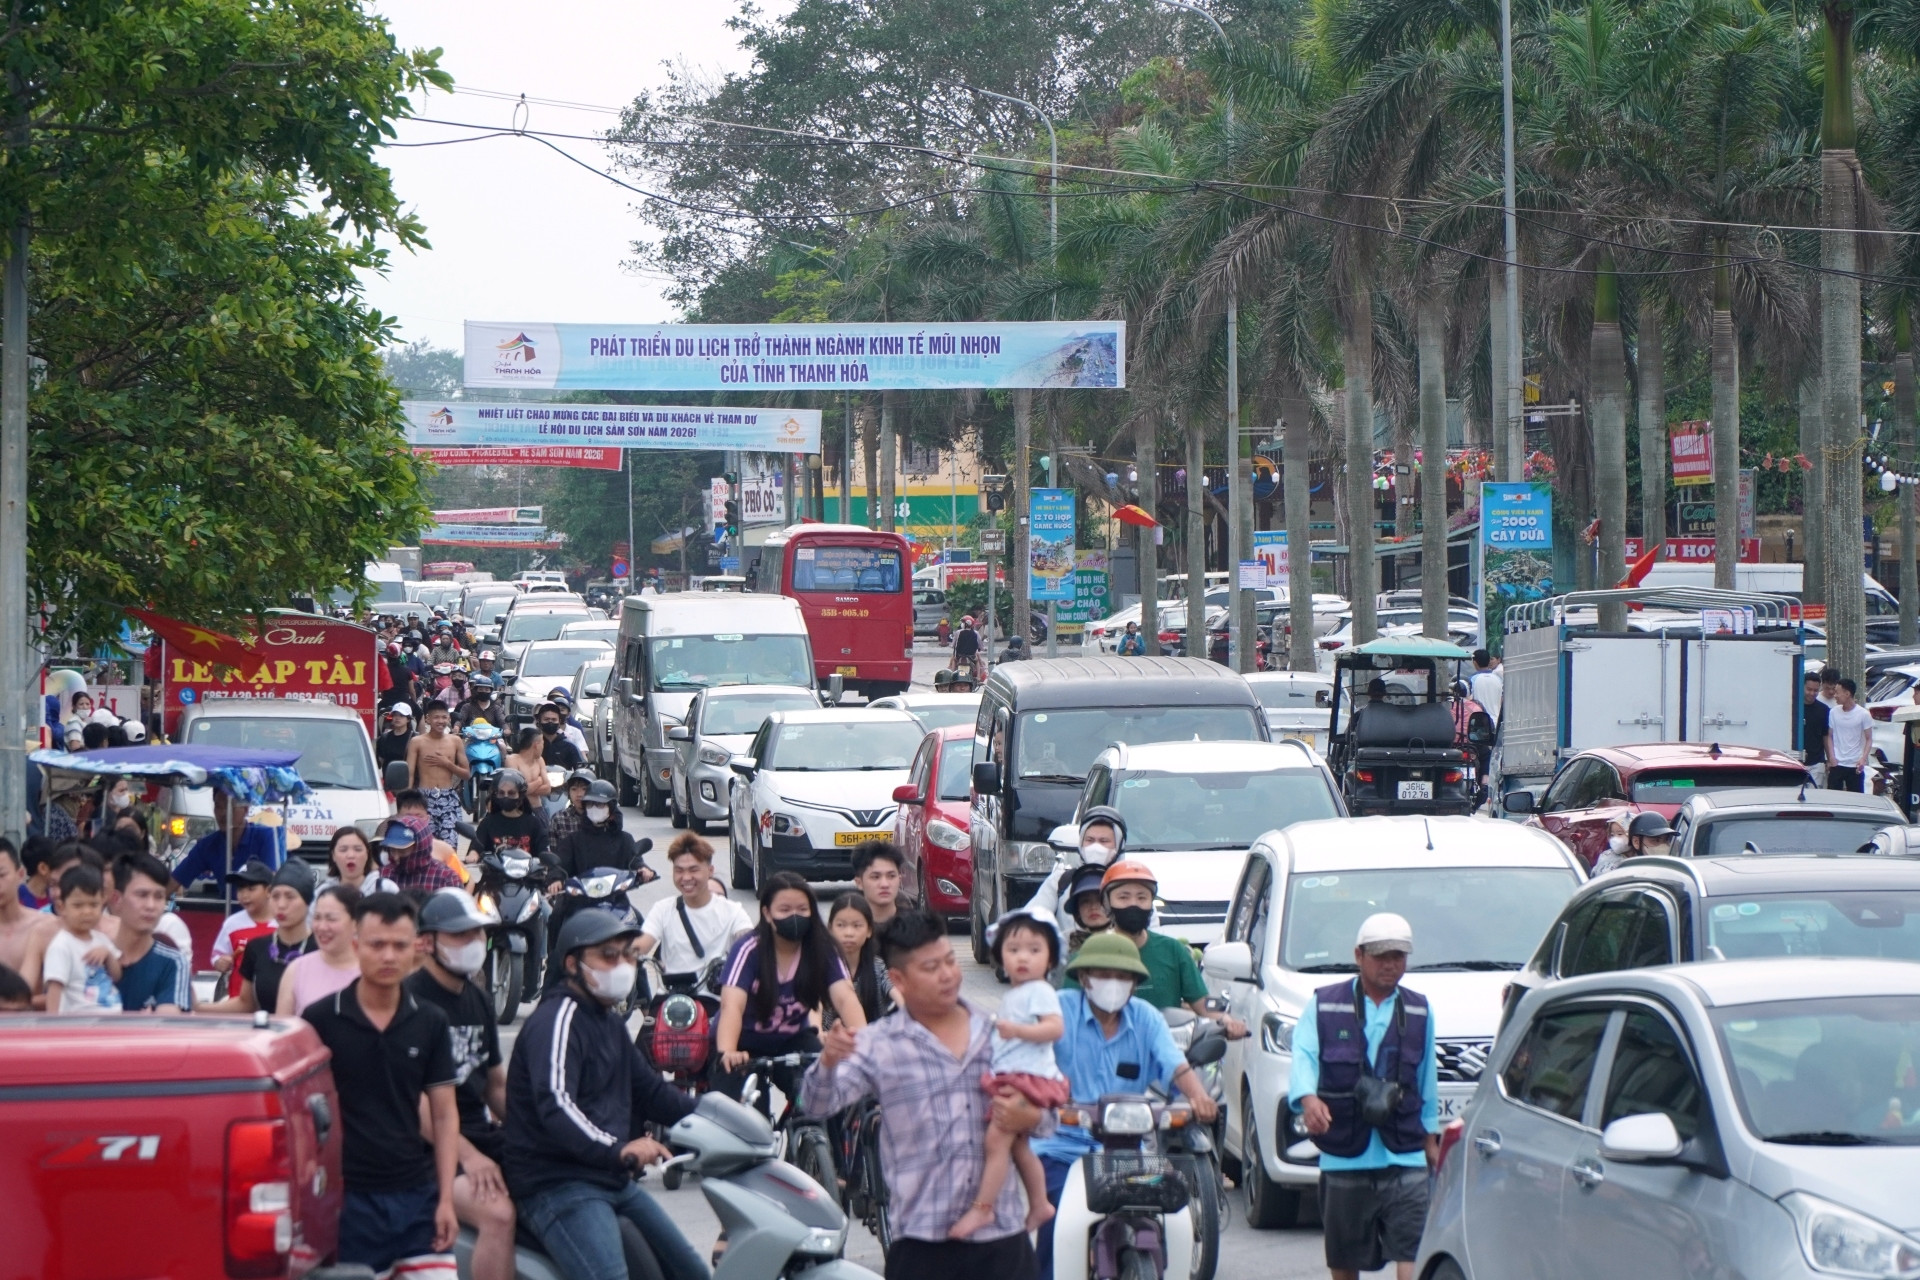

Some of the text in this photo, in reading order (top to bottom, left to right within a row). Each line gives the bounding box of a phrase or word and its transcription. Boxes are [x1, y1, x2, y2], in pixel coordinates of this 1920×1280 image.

[590, 330, 1001, 360] PHÁT TRIỂN DU LỊCH TRỞ THÀNH NGÀNH KINH TẾ MŨI NHỌN
[720, 358, 749, 383] CỦA
[752, 358, 785, 383] TỈNH
[789, 364, 836, 383] THANH
[840, 360, 869, 382] HÓA
[478, 408, 504, 420] NHIỆT
[656, 412, 669, 423] DU
[717, 414, 742, 425] THAM
[550, 424, 566, 437] HỘI
[568, 425, 581, 435] DU
[583, 425, 603, 437] LỊCH
[627, 425, 646, 437] SƠN
[670, 427, 697, 438] 2026!
[583, 449, 604, 460] 2026!
[1502, 516, 1537, 527] 2000
[1490, 527, 1545, 541] CÂY DỪA
[304, 653, 367, 685] TÀI
[1405, 782, 1426, 791] 36HC
[302, 806, 334, 820] TÀI
[311, 825, 323, 836] 155
